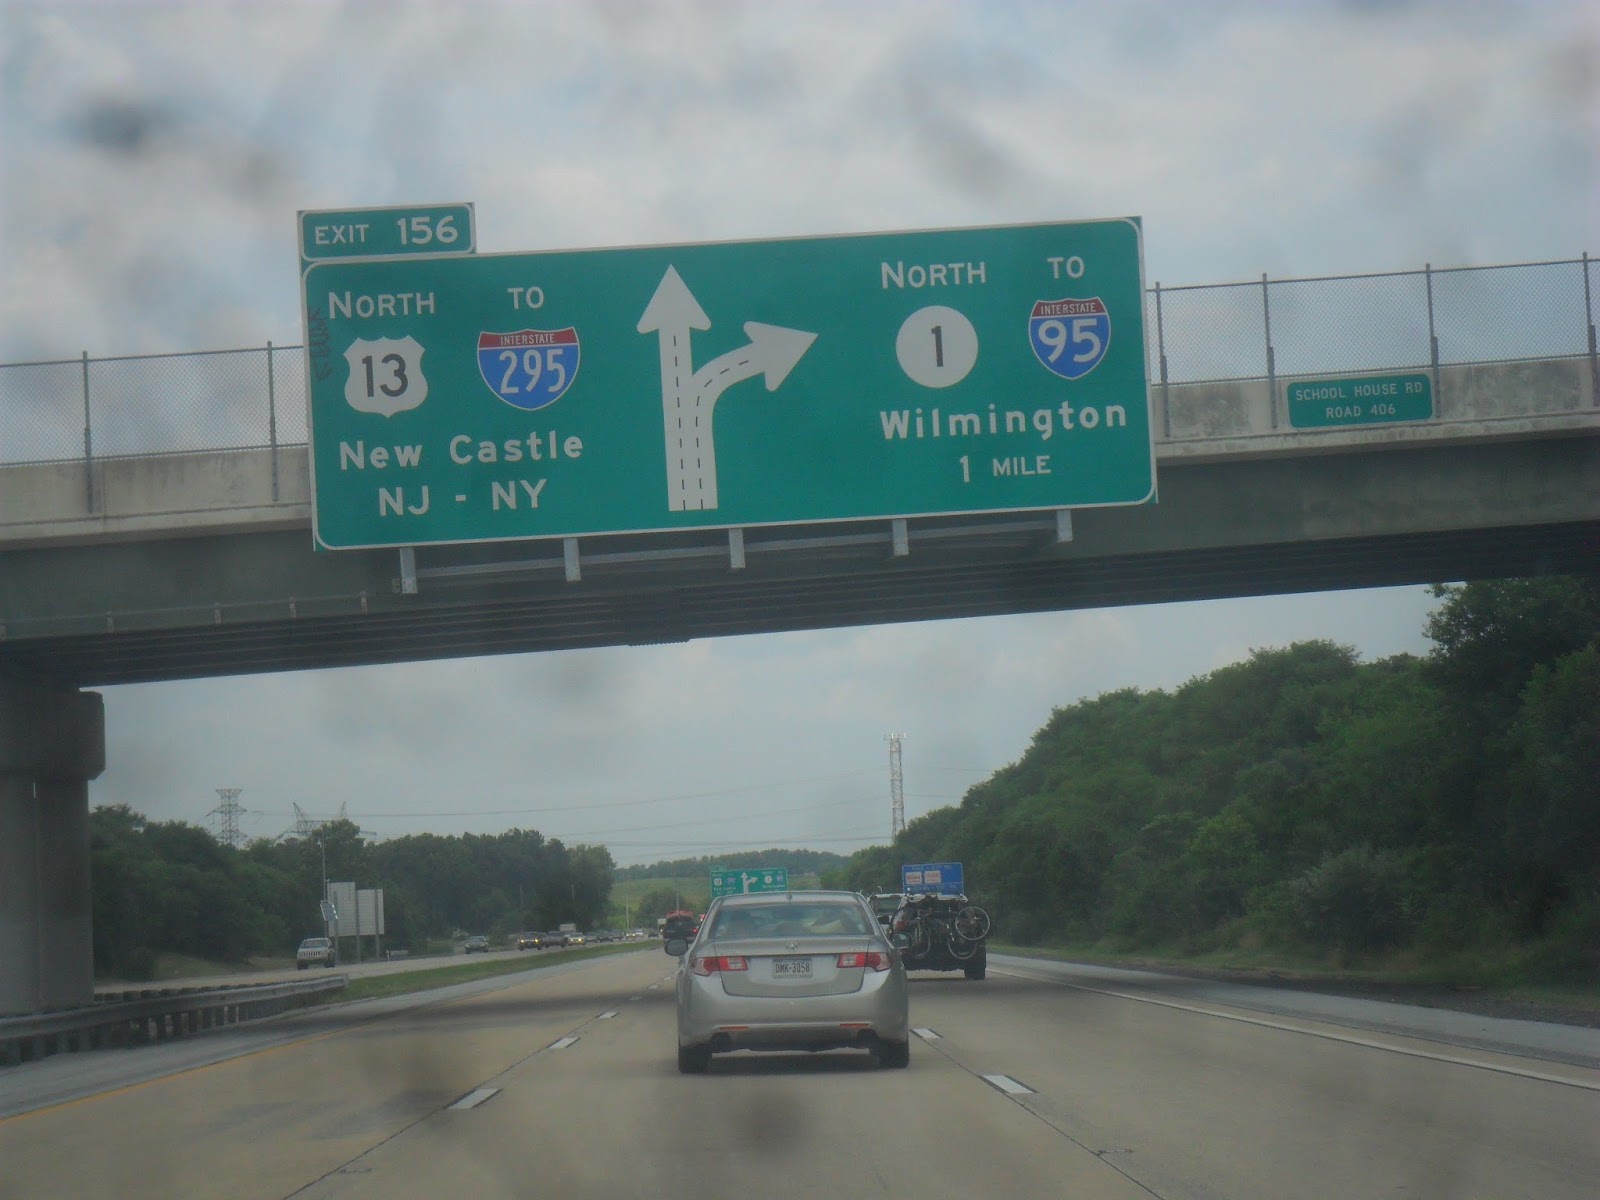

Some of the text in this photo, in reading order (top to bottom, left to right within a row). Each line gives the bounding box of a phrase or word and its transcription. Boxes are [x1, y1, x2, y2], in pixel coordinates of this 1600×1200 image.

[315, 216, 459, 245] EXIT 156
[881, 261, 986, 289] NORTH
[1047, 256, 1085, 279] TO
[328, 291, 435, 319] NORTH
[508, 286, 544, 310] TO
[1040, 302, 1096, 315] INTERSTATE
[500, 333, 555, 346] INTERSTATE
[931, 325, 944, 368] 1
[1038, 319, 1101, 363] 95
[362, 353, 408, 398] 13
[499, 349, 566, 394] 295
[1296, 382, 1423, 400] SCHOOL HOUSE RD
[880, 401, 1126, 440] Wilmington
[1326, 403, 1396, 418] ROAD 406
[339, 431, 583, 470] New Castle
[959, 455, 1051, 483] 1 MILE
[378, 486, 429, 517] NJ
[492, 478, 547, 510] NY
